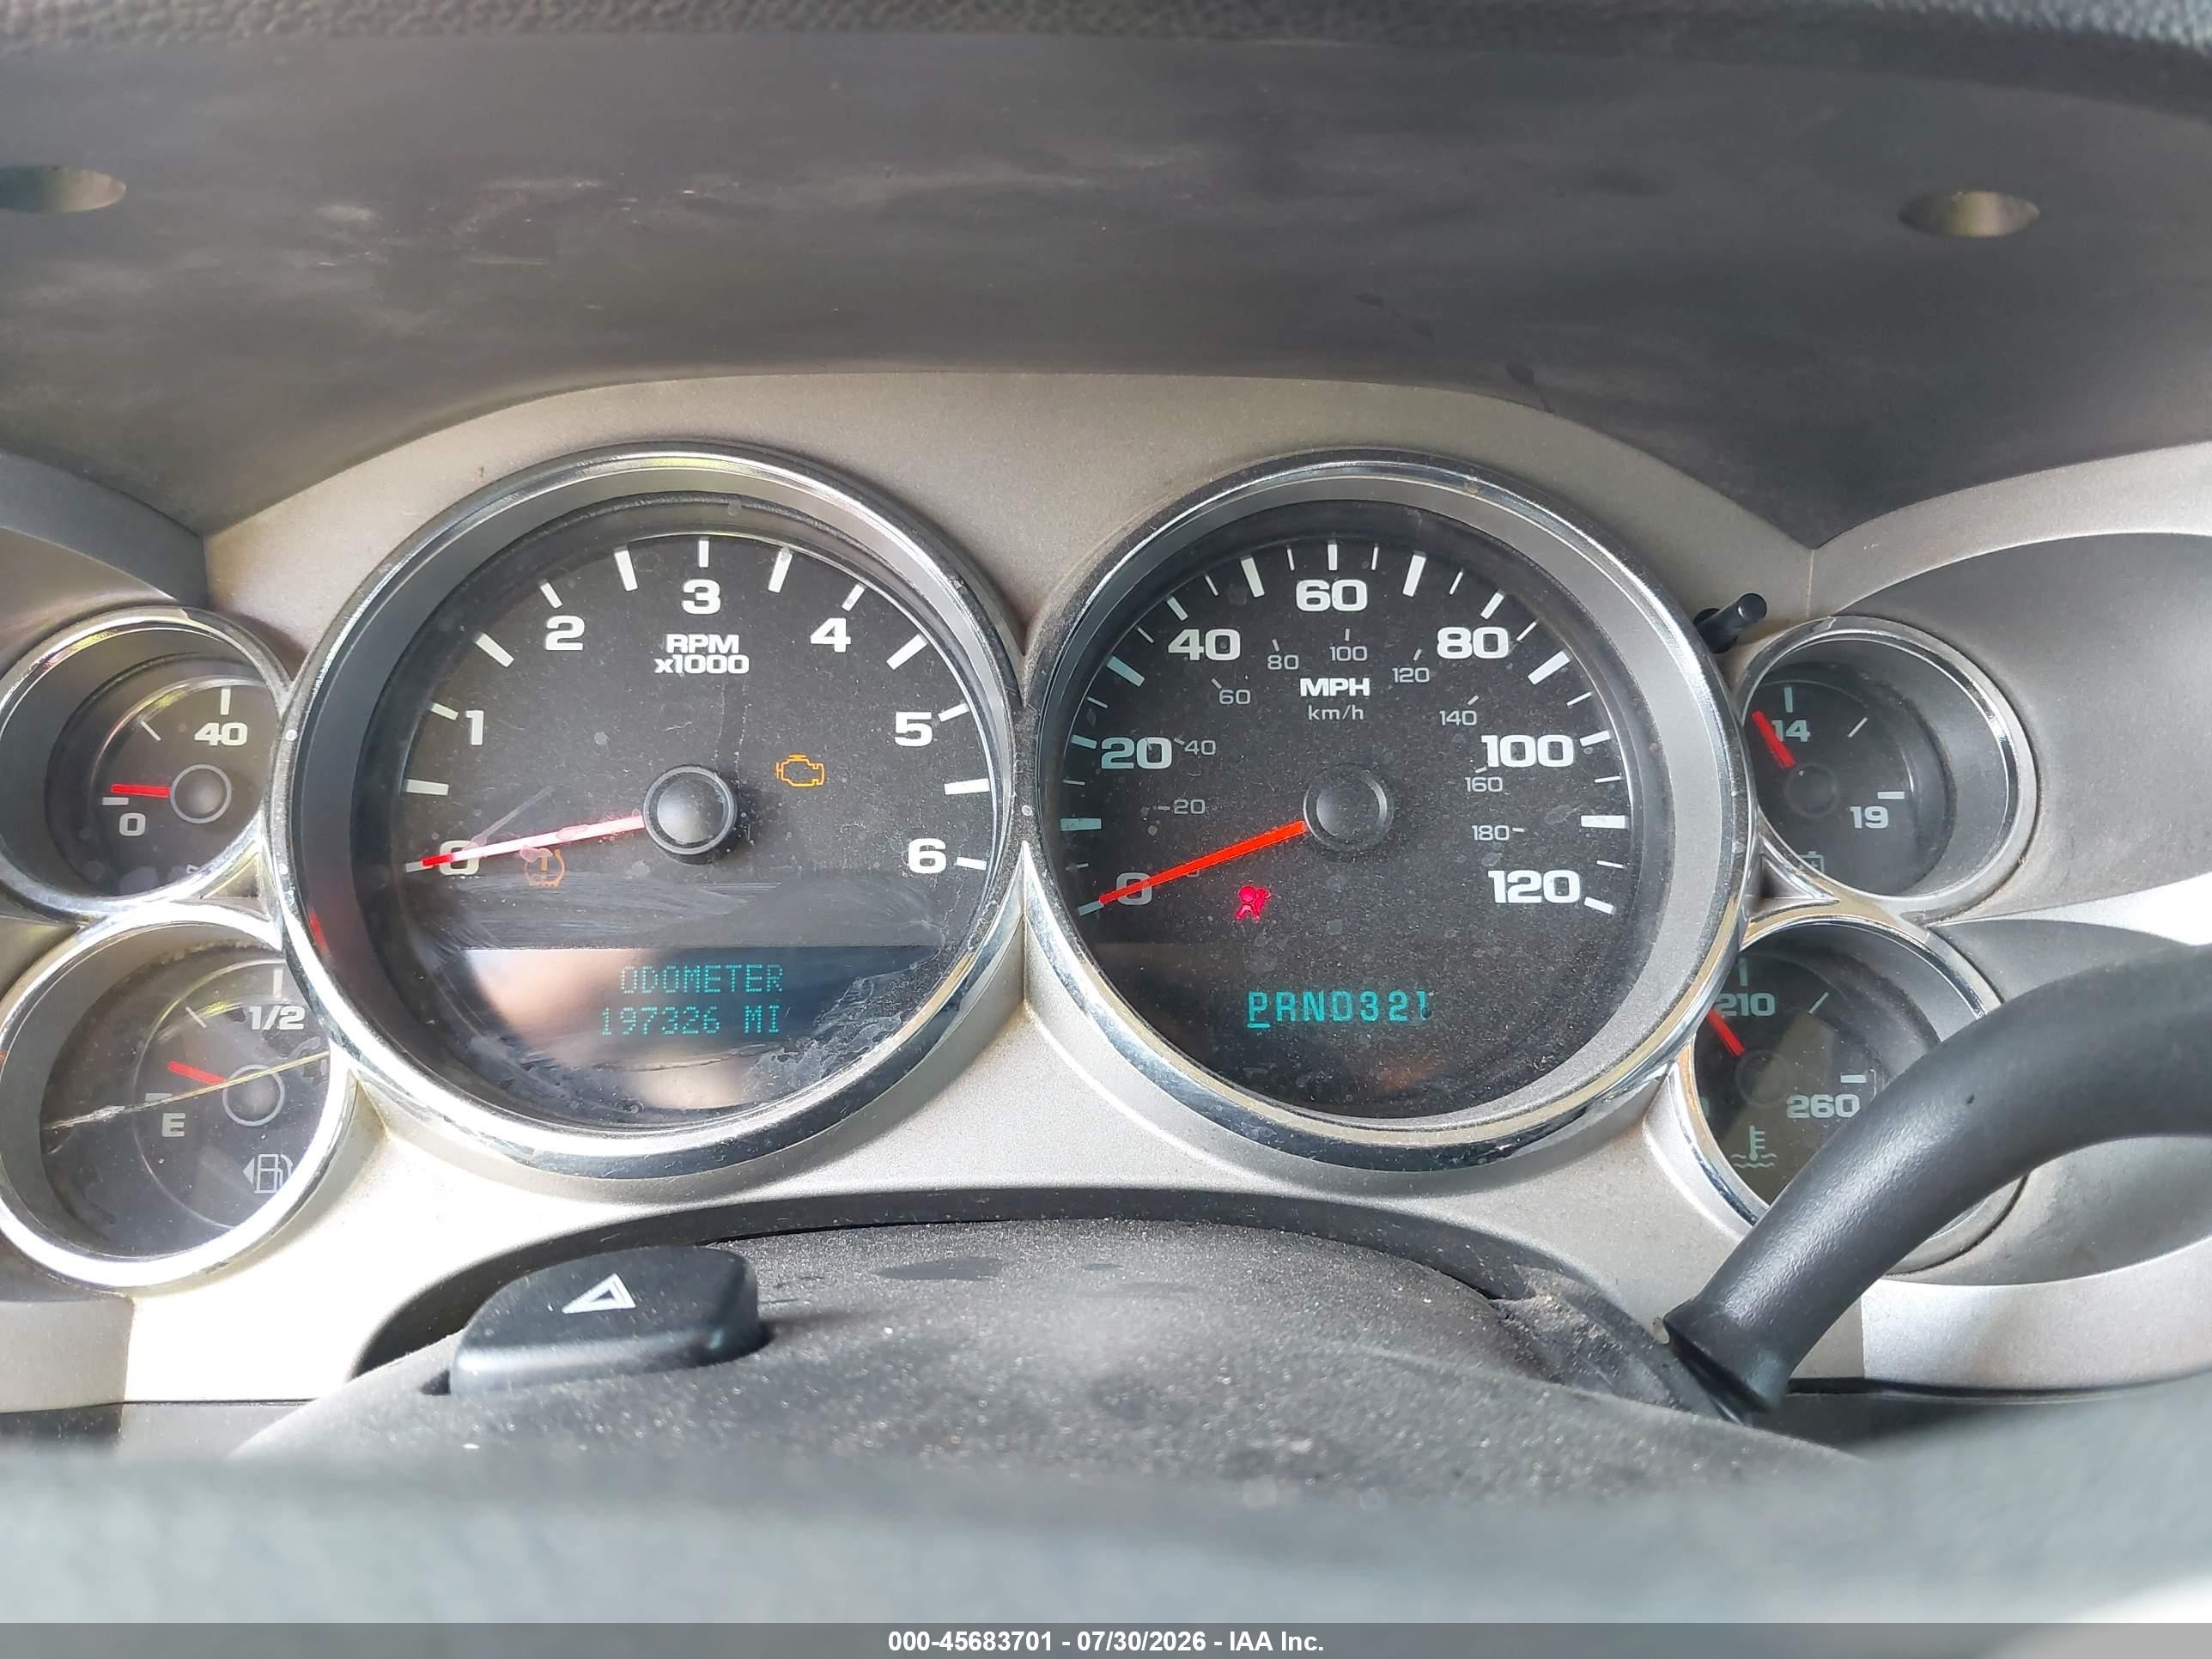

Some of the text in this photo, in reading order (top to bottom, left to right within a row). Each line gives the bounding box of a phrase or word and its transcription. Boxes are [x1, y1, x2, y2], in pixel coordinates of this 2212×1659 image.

[683, 579, 720, 615] 3
[1296, 580, 1367, 611] 60
[546, 615, 585, 651] 2
[665, 634, 739, 654] RPM
[811, 618, 851, 653] 4
[1169, 629, 1240, 660] 40
[1437, 627, 1509, 659] 80
[654, 654, 749, 674] x1000
[1267, 653, 1299, 671] 80
[1329, 646, 1368, 662] 100
[1300, 678, 1370, 696] MPH
[1392, 667, 1430, 684] 120
[1218, 689, 1251, 706] 60
[1308, 705, 1364, 722] km/h
[1439, 710, 1477, 726] 140
[194, 722, 248, 745] 40
[466, 710, 483, 745] 1
[896, 712, 933, 746] 5
[1771, 720, 1811, 742] 14
[1101, 737, 1173, 769] 20
[1184, 739, 1216, 756] 40
[1481, 734, 1574, 768] 100
[1465, 776, 1503, 793] 160
[1173, 799, 1206, 815] 20
[1850, 806, 1889, 829] 19
[119, 813, 146, 836] 0
[1472, 825, 1510, 842] 180
[440, 840, 479, 875] 0
[908, 838, 946, 874] 6
[1116, 872, 1152, 906] 0
[1487, 869, 1581, 904] 120
[620, 963, 783, 994] ODOMETER
[1717, 993, 1776, 1017] 210
[248, 1006, 305, 1030] 1/2
[601, 1005, 780, 1036] 197326 MI
[1787, 1094, 1860, 1118] 260
[161, 1113, 185, 1137] E
